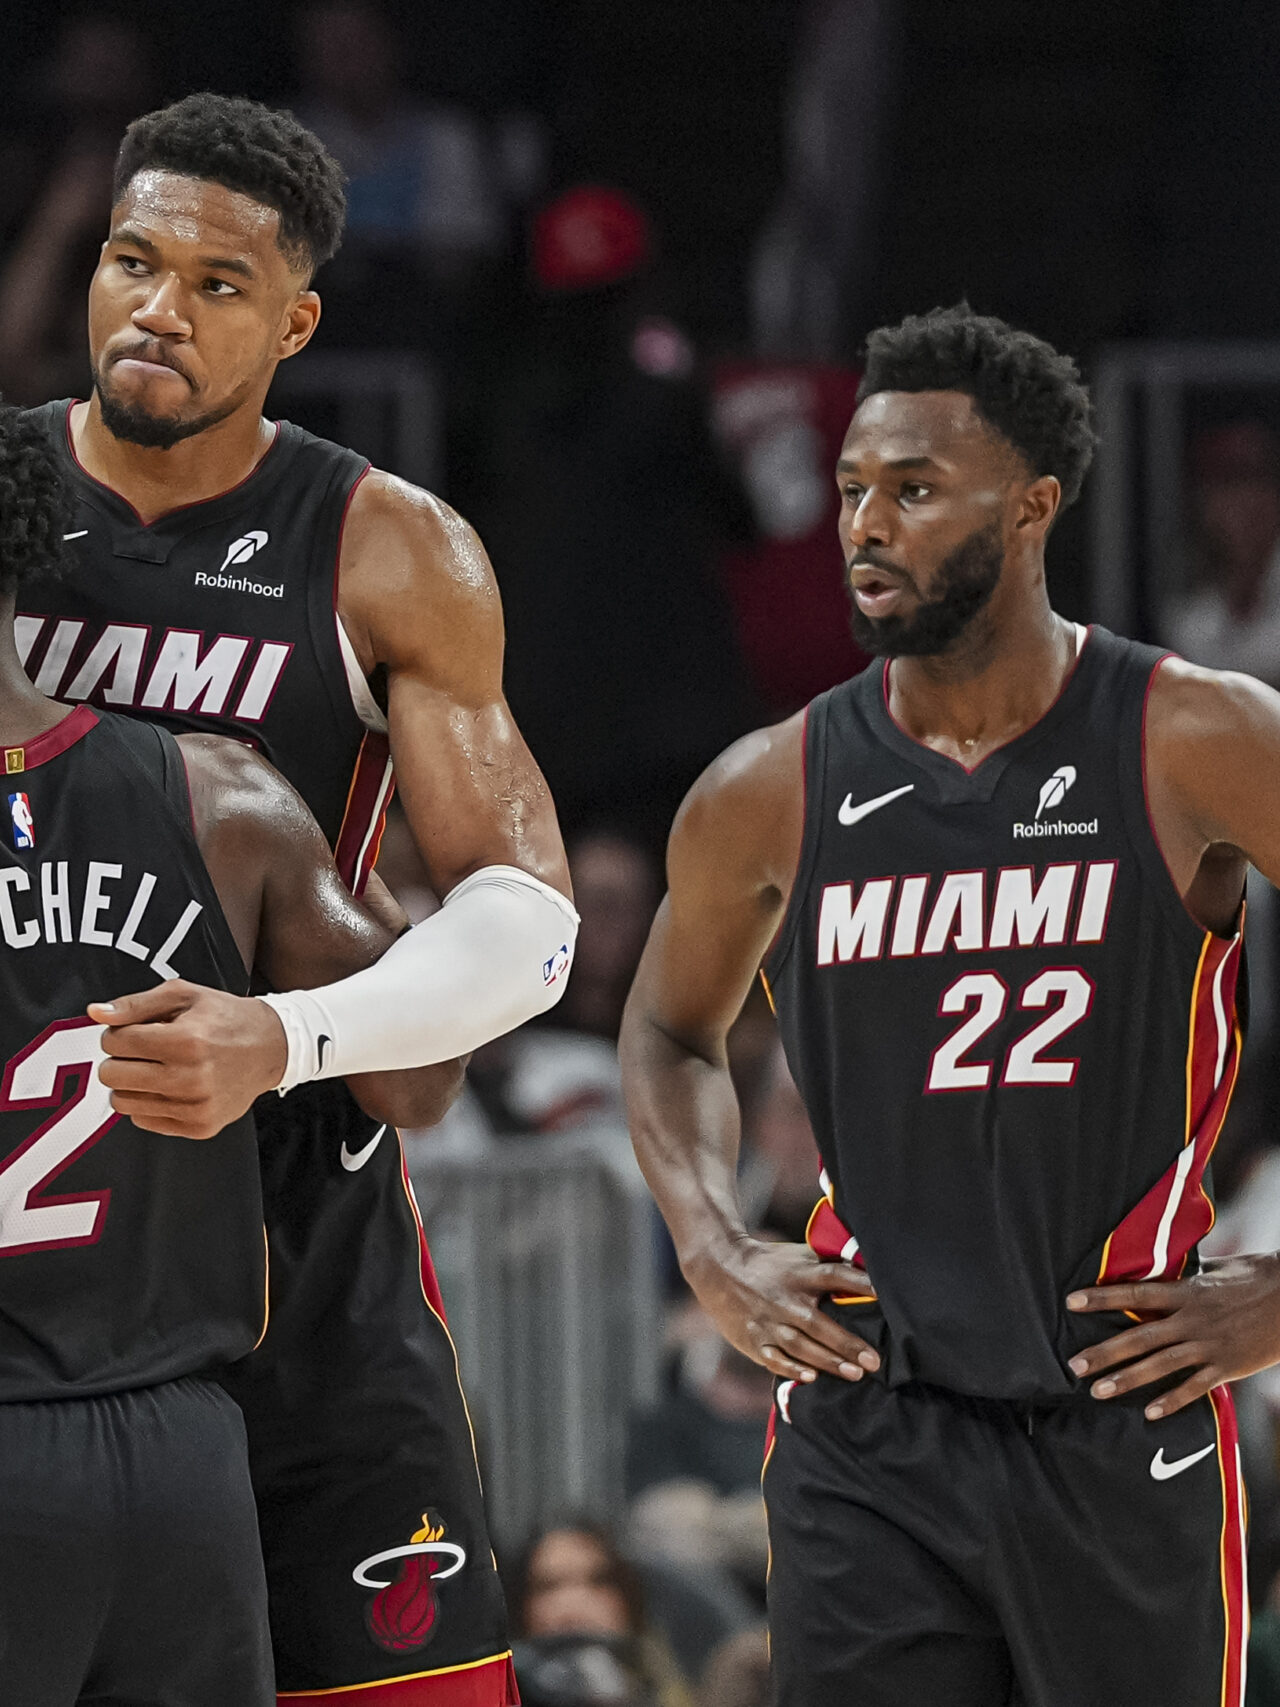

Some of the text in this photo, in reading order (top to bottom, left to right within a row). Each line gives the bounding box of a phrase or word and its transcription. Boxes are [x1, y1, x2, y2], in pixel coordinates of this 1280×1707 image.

[194, 571, 284, 598] Robinhood
[1013, 818, 1098, 838] Robinhood
[816, 859, 1118, 967] MIAMI
[924, 966, 1096, 1093] 22
